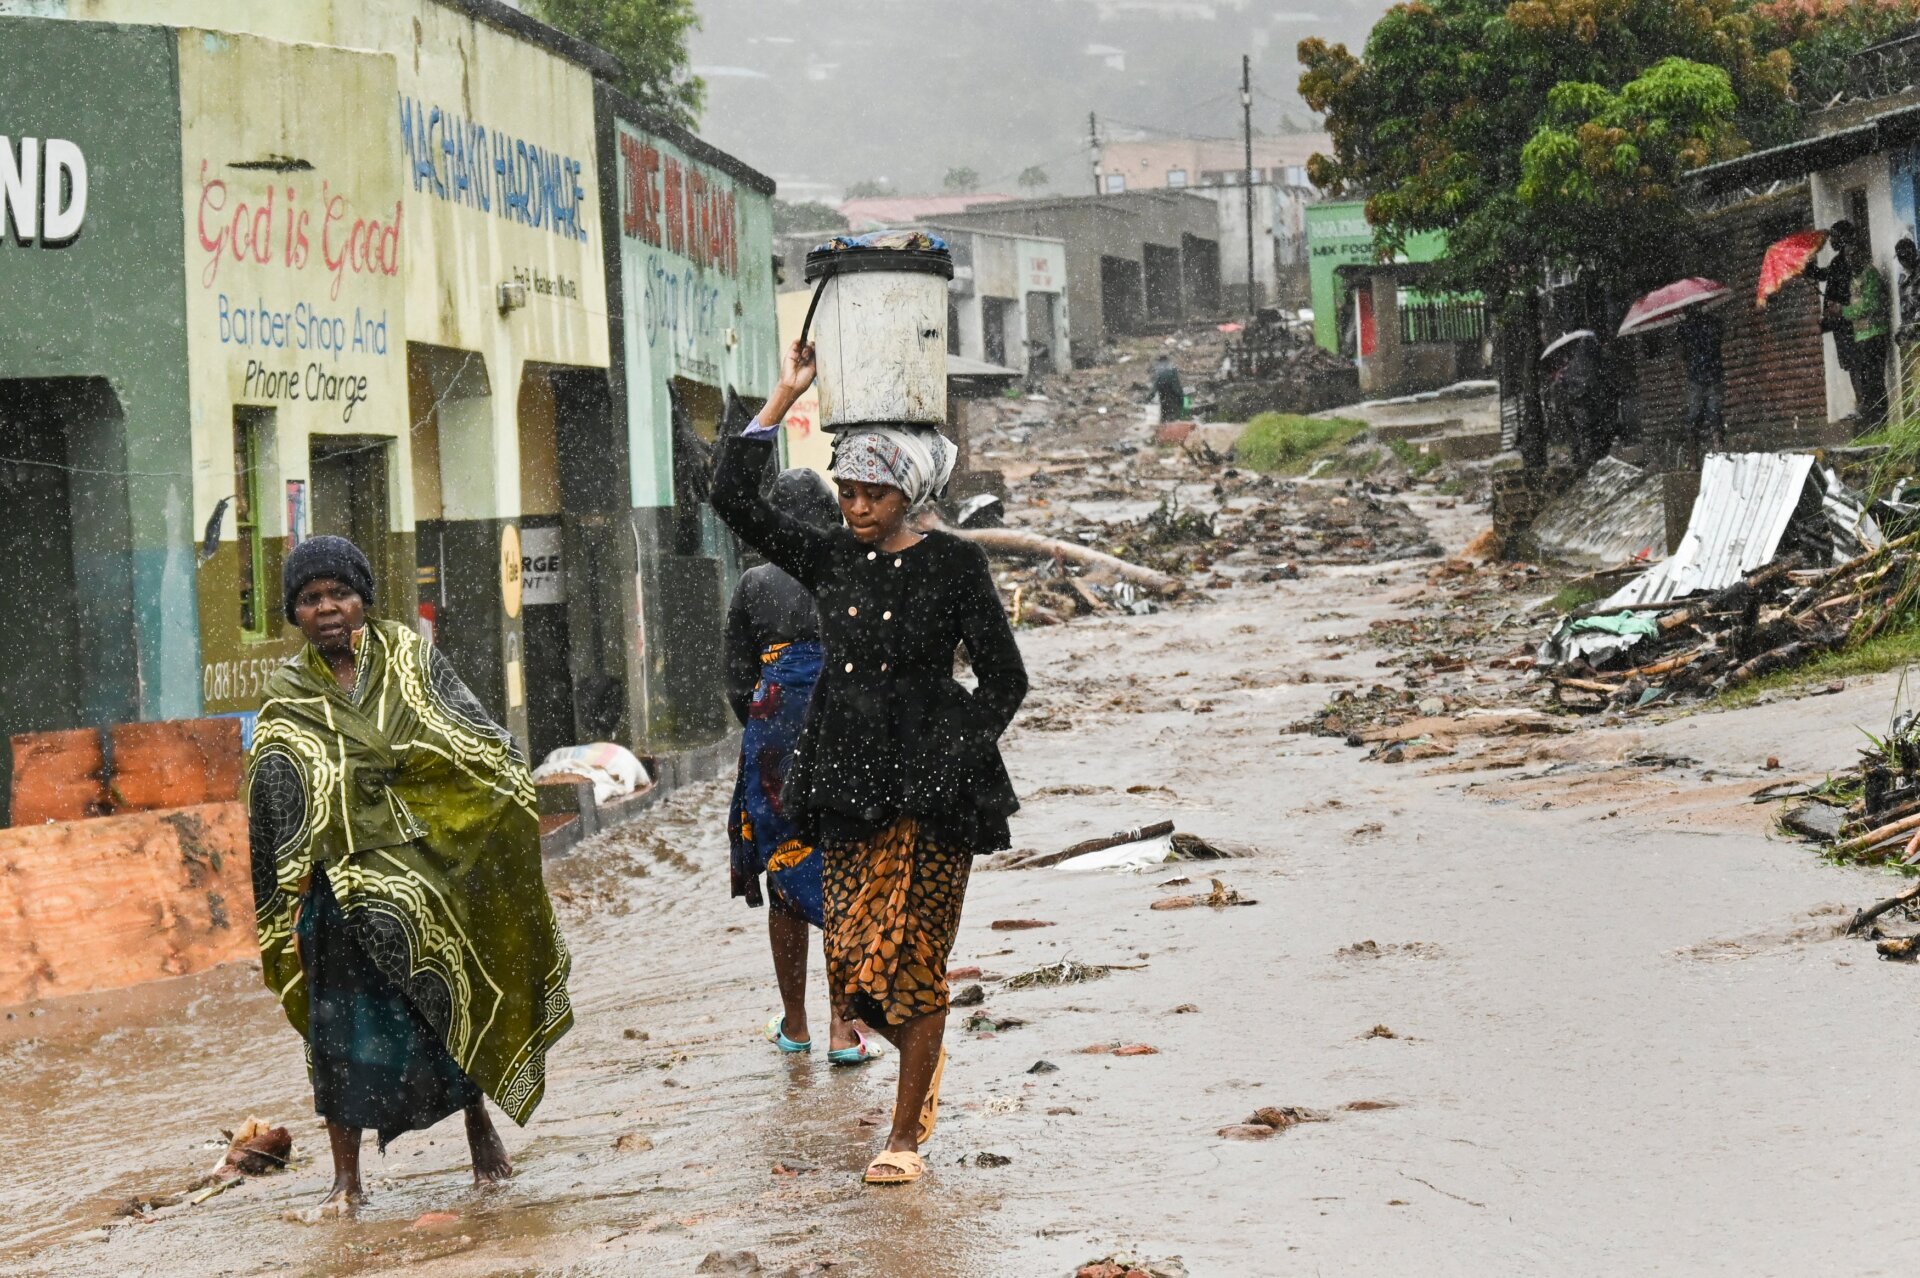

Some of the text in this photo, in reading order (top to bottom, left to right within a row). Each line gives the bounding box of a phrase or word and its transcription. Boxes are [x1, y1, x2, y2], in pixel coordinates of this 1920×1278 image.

[198, 159, 403, 301] God is Good
[493, 129, 588, 244] HARDWARE
[218, 294, 387, 362] Barber Shop And
[243, 360, 368, 423] Phone Charge
